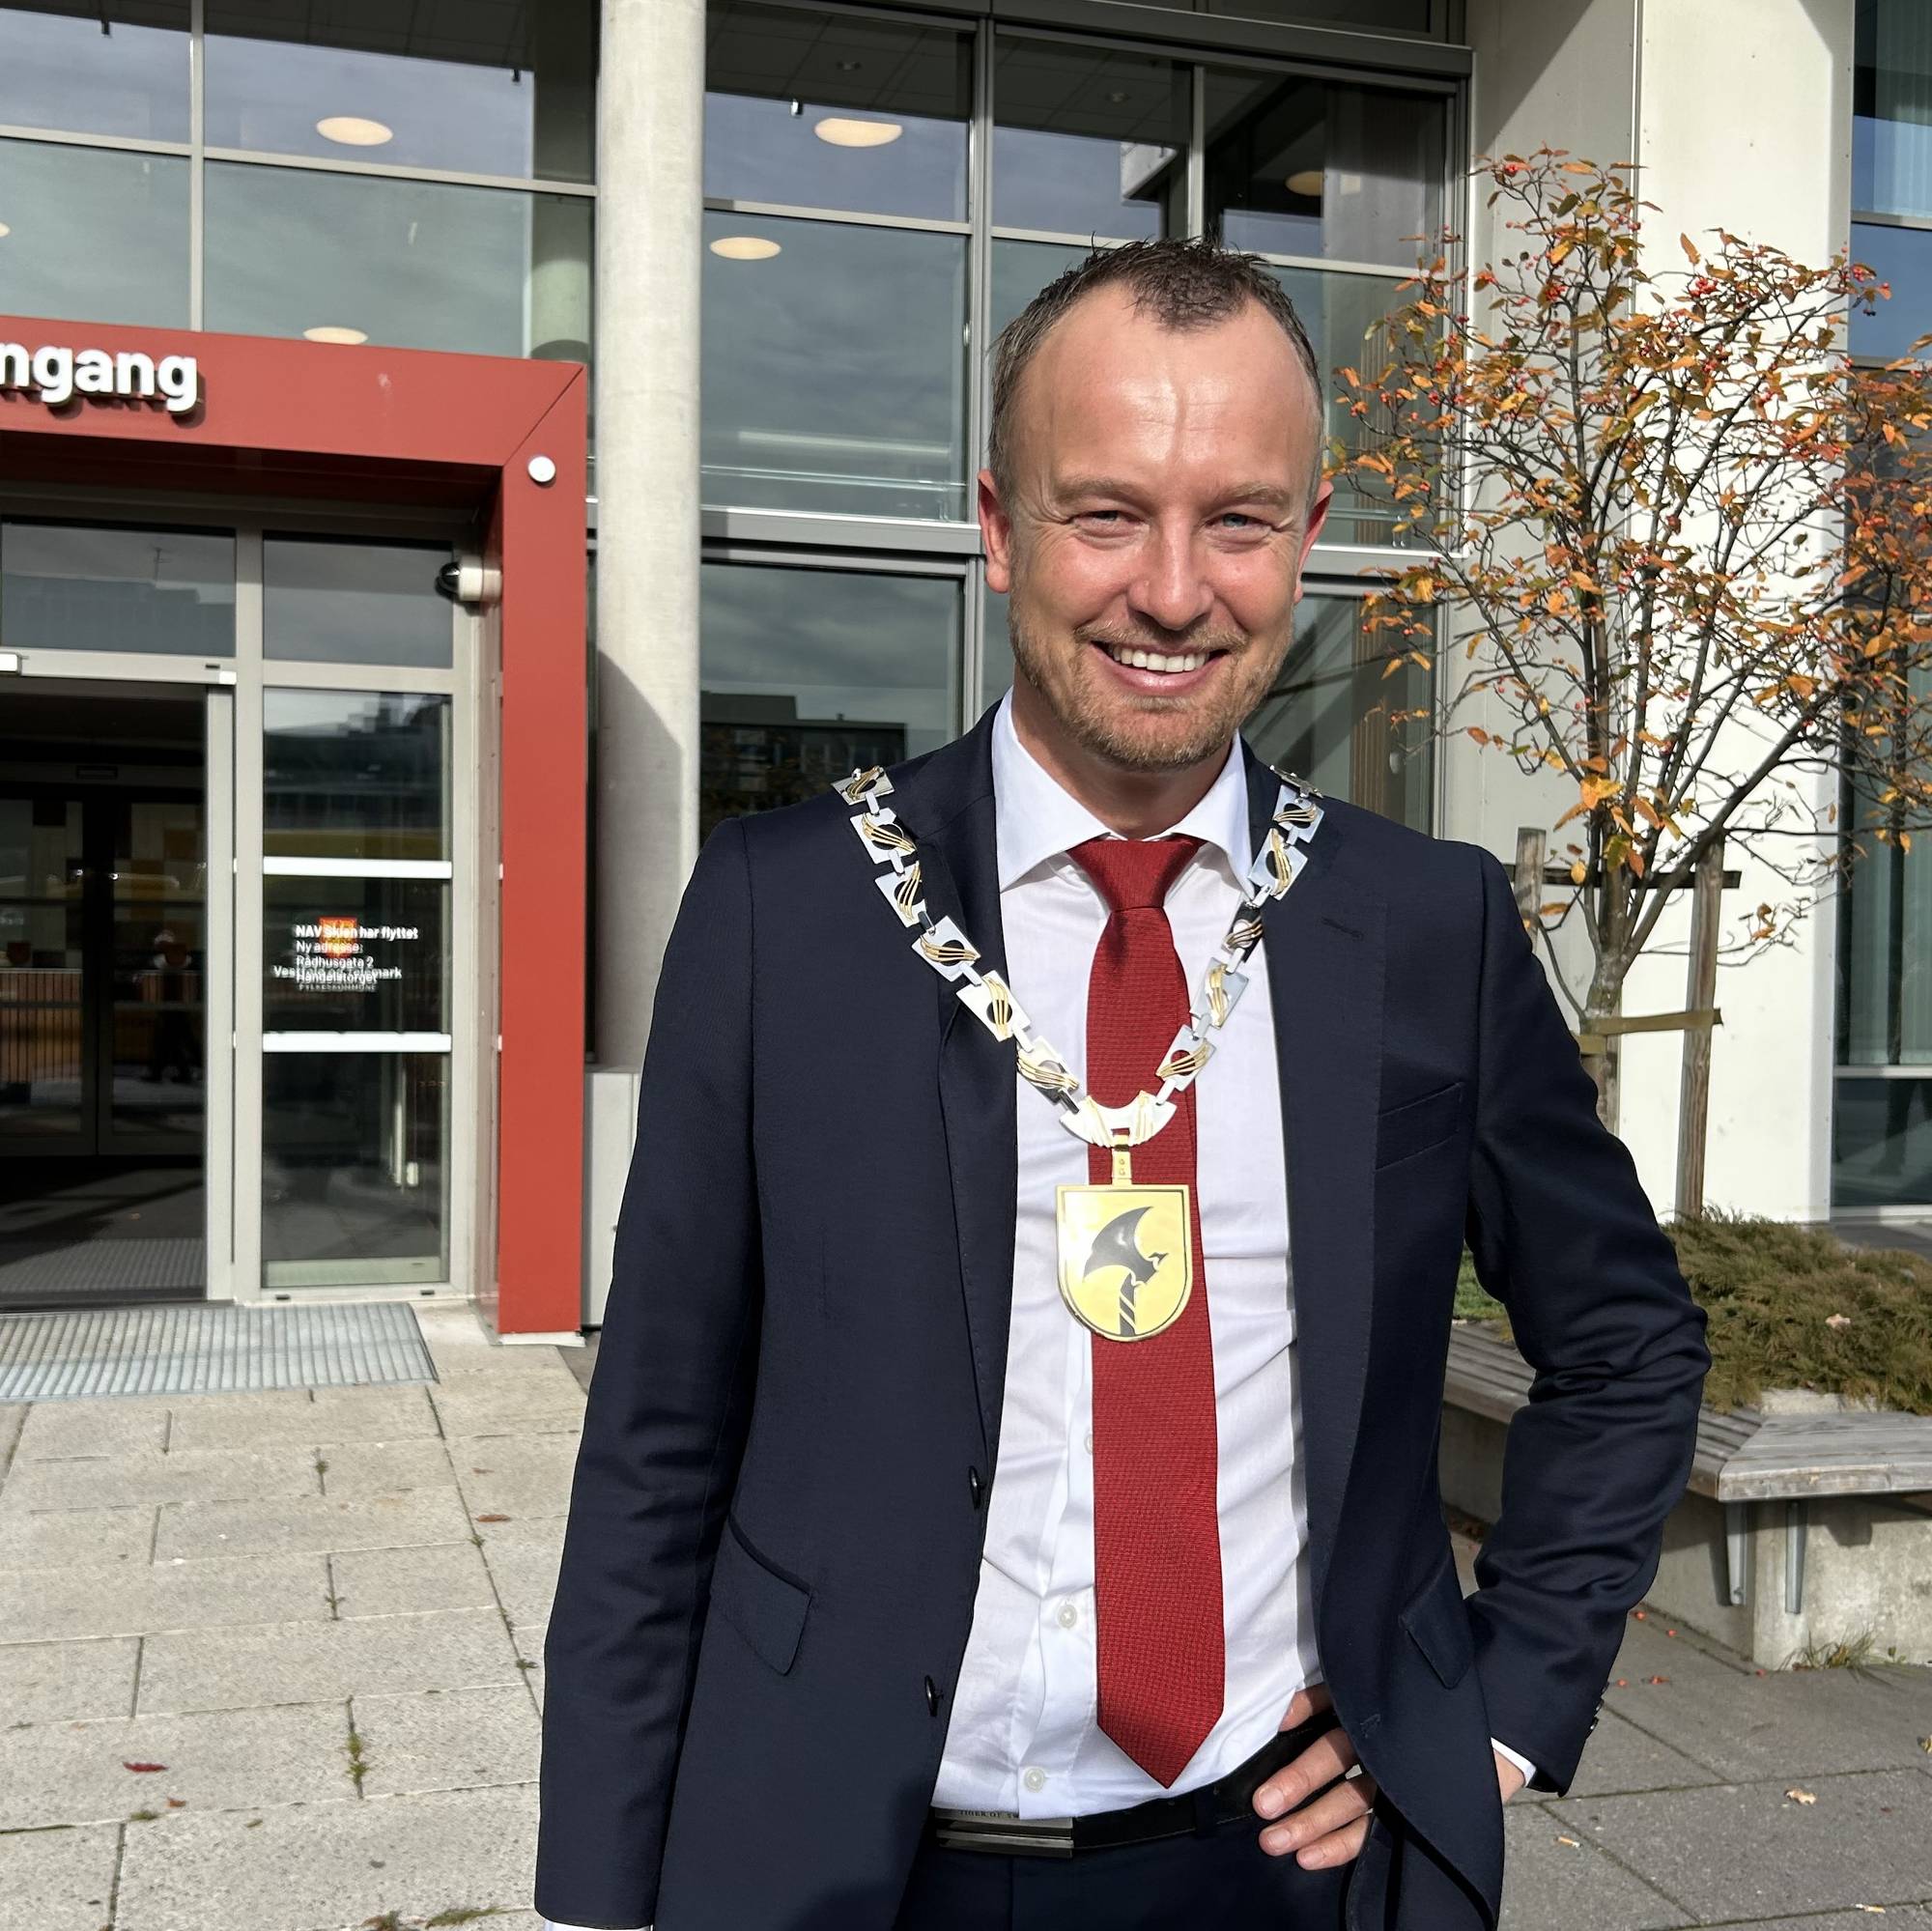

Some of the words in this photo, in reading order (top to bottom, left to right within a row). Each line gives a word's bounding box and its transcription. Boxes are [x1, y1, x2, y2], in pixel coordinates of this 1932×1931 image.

[0, 341, 198, 413] ngang
[295, 924, 322, 938] NAV
[323, 924, 358, 938] Skien
[359, 925, 380, 939] har
[381, 925, 419, 942] flyttet
[296, 940, 312, 954] Ny
[366, 955, 375, 967] 2
